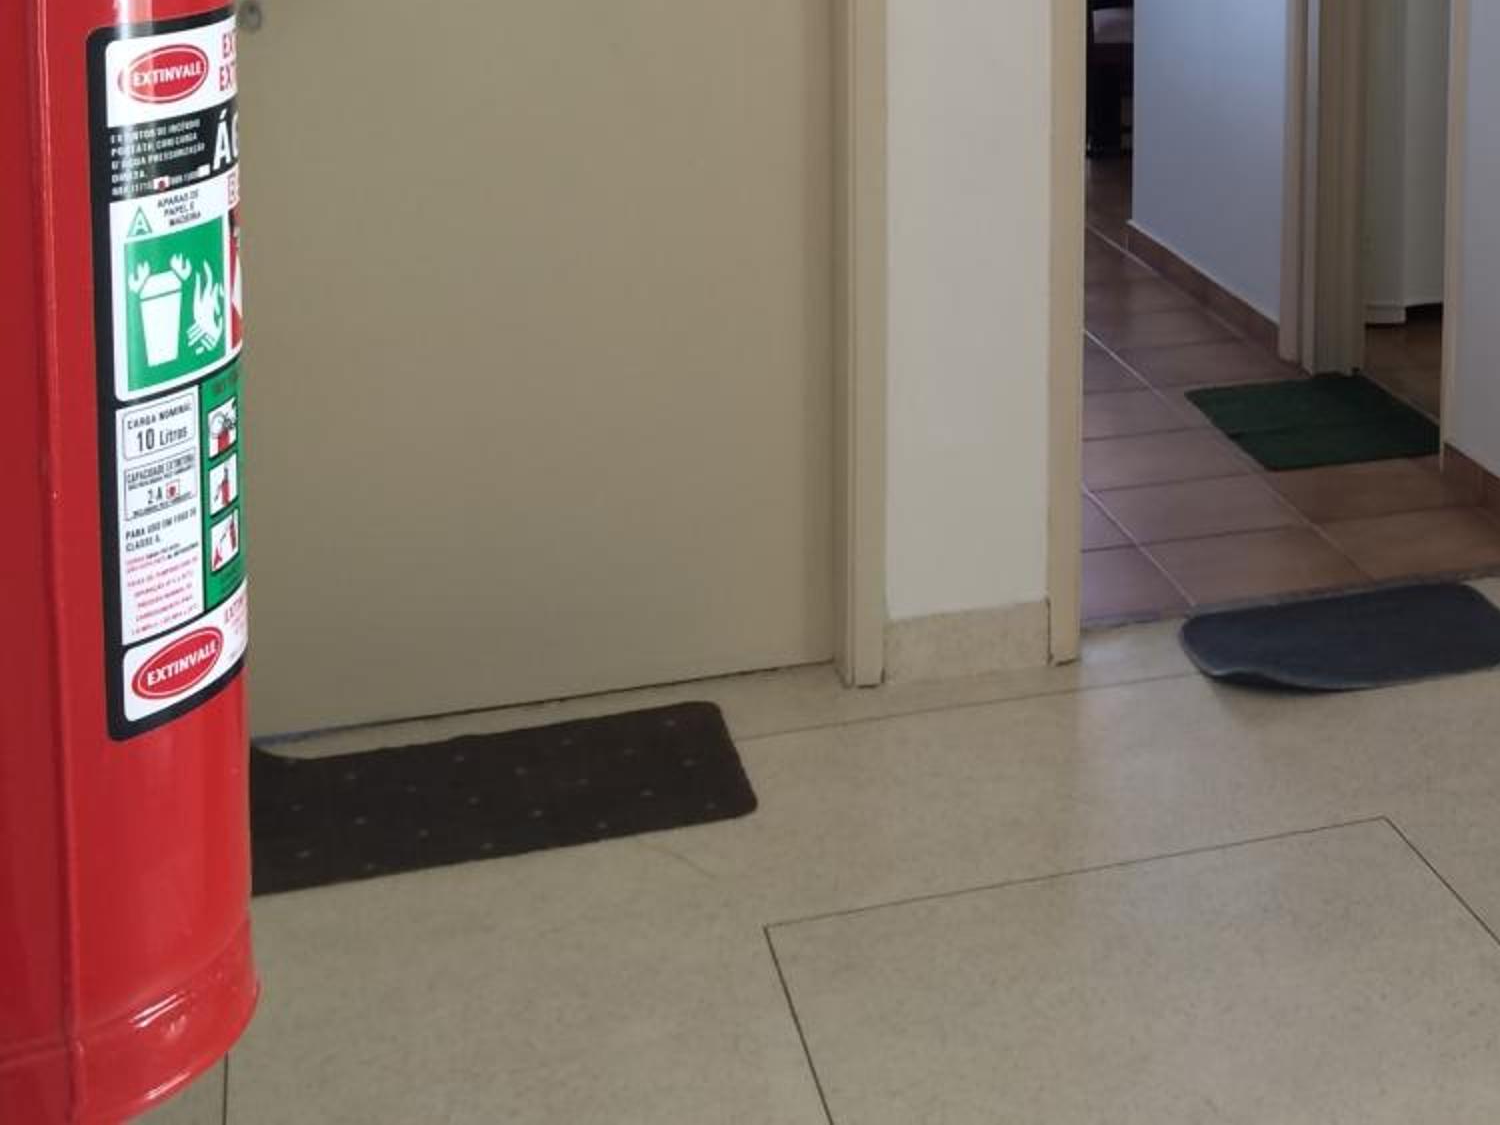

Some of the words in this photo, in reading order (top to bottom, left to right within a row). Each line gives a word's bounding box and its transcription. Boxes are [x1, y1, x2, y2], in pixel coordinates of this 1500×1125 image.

[133, 62, 202, 86] EXTINVALE
[127, 414, 156, 430] CARGA
[160, 404, 191, 420] NOMINAL
[137, 427, 155, 452] 10
[159, 426, 188, 446] Litros
[126, 526, 145, 540] PARA
[147, 640, 217, 686] EXTINVALE
